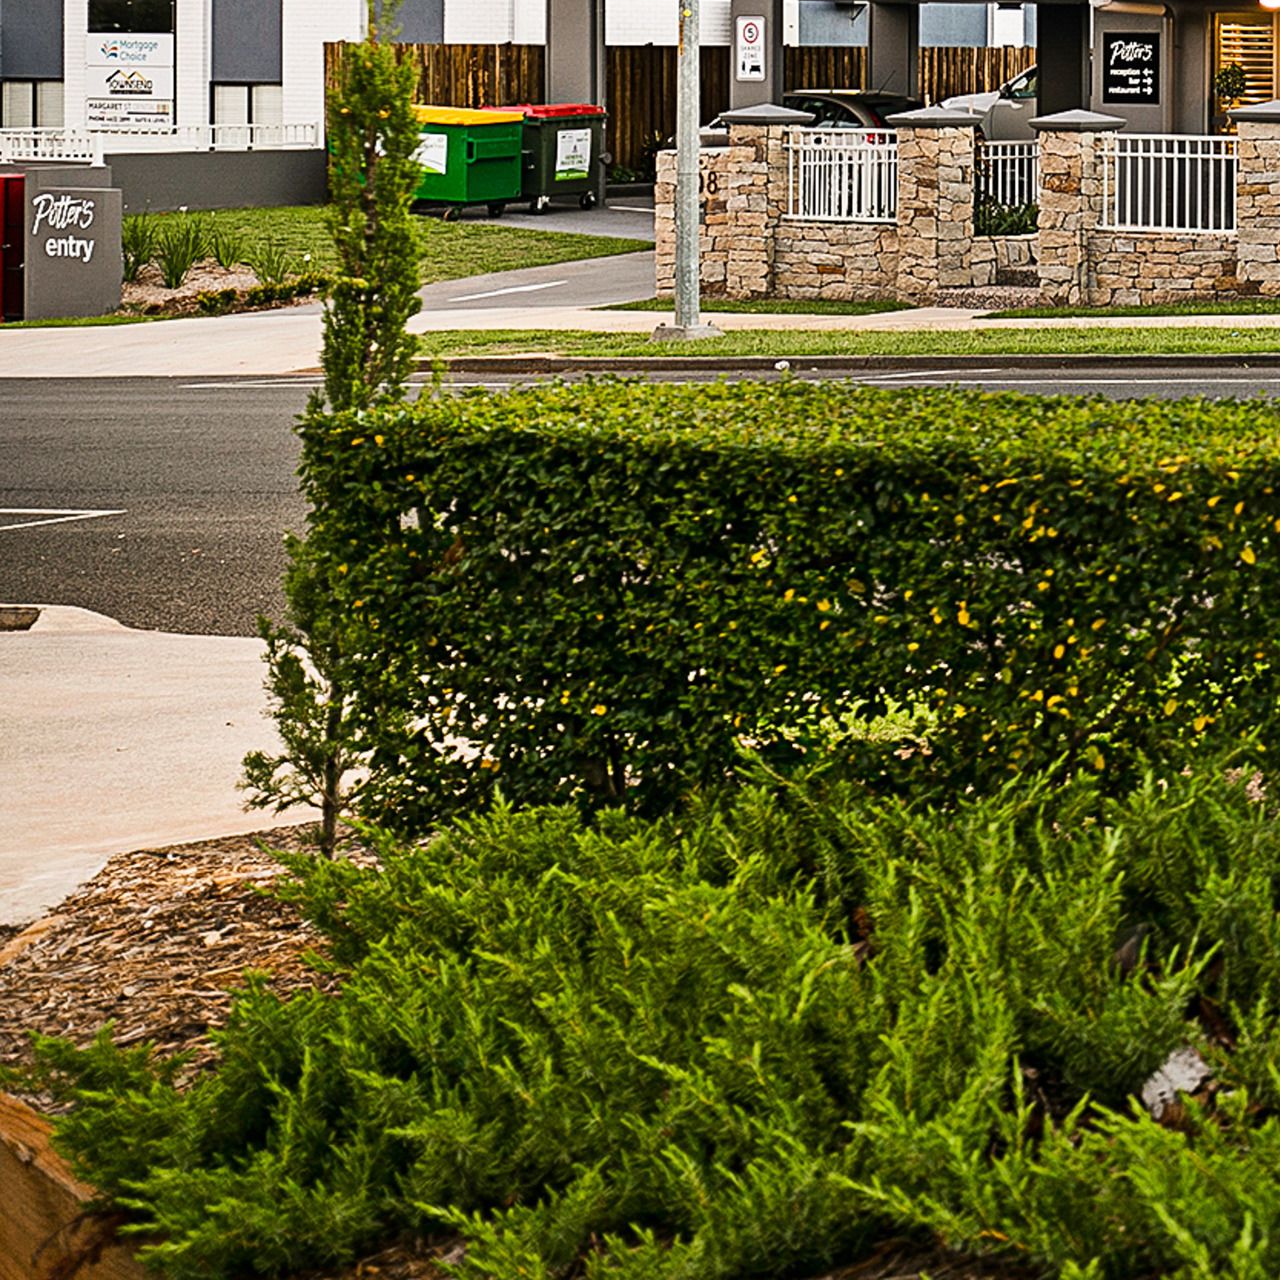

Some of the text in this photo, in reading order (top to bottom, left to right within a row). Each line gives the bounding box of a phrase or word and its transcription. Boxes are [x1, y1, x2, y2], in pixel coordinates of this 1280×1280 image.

[747, 27, 754, 38] 5
[120, 40, 158, 51] Mortgage
[120, 51, 147, 60] Choice
[89, 102, 122, 110] MARGARET
[32, 193, 95, 235] Potter's
[45, 235, 95, 263] entry
